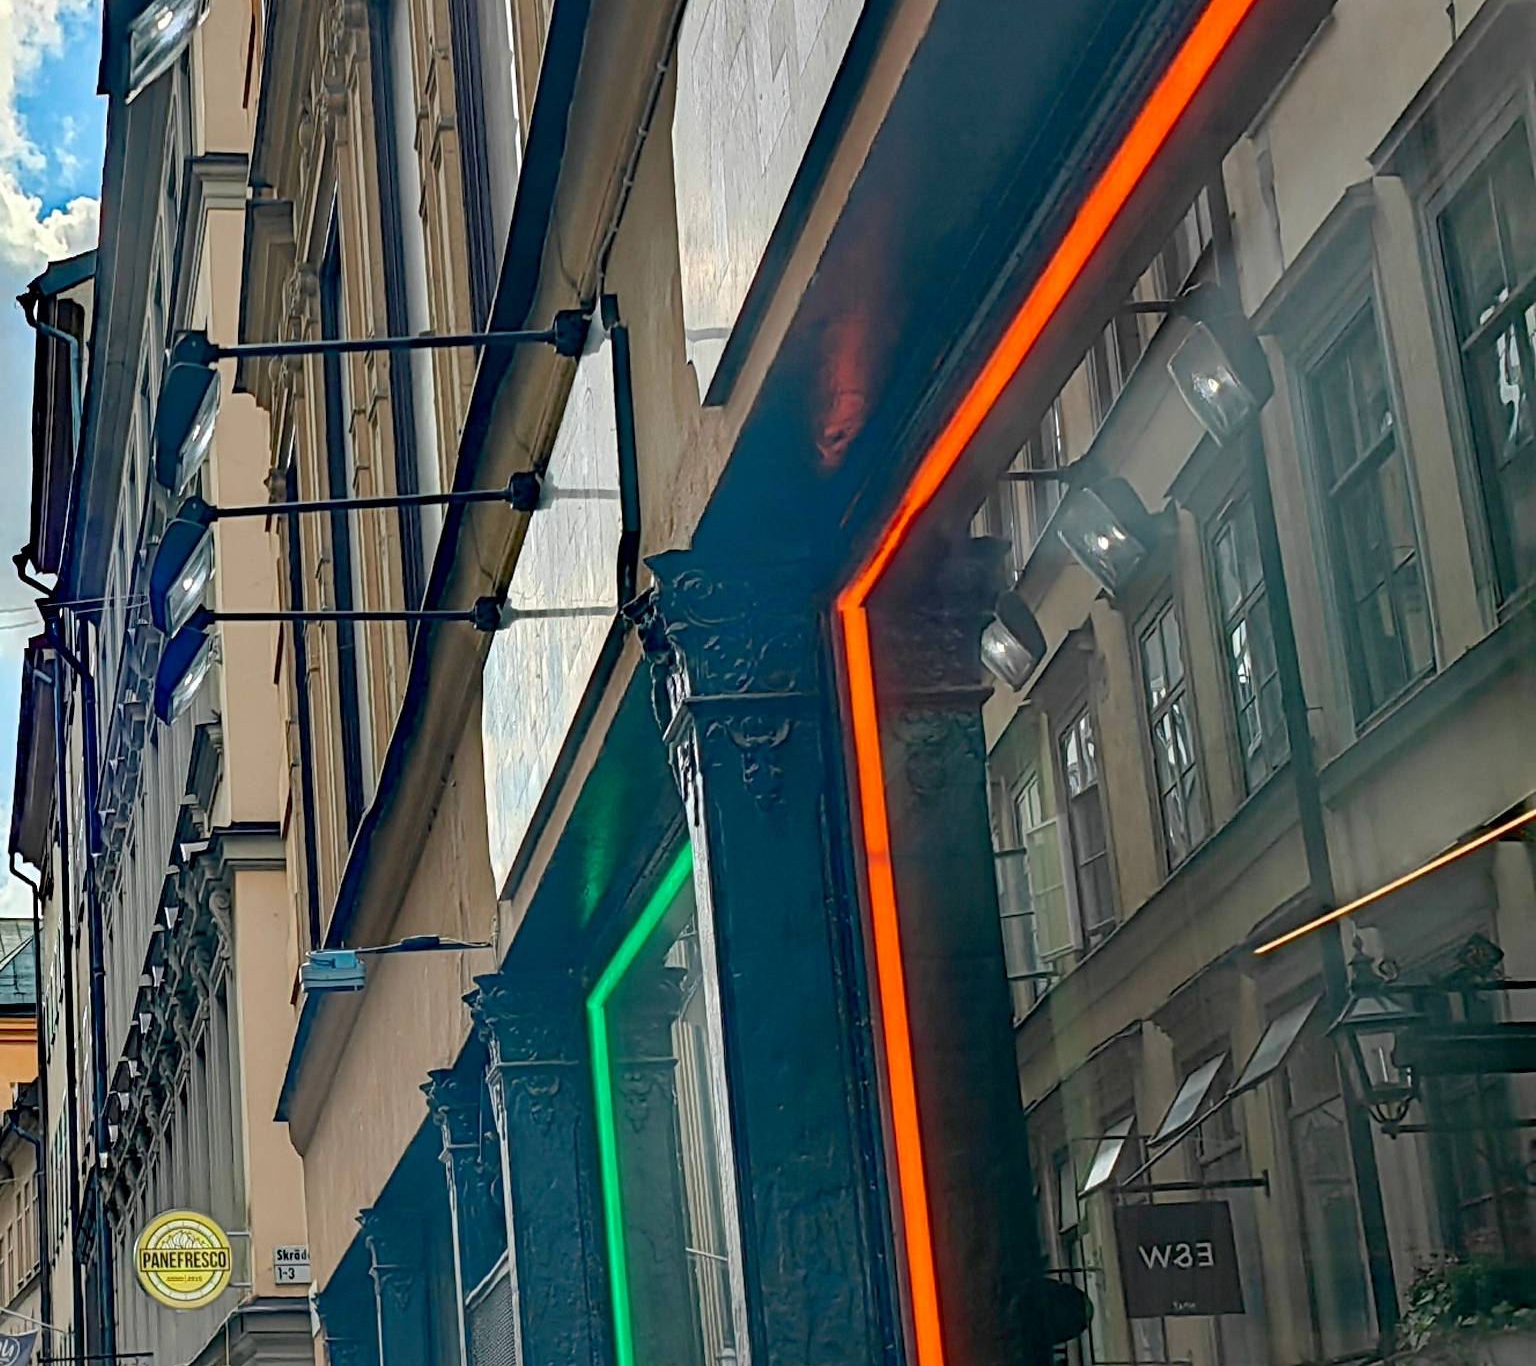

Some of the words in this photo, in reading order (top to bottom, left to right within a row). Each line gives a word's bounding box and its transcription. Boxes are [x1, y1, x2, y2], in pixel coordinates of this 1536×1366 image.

[143, 1251, 227, 1268] PANEFRESCO
[276, 1248, 310, 1261] Skräd
[278, 1267, 295, 1280] 1-3
